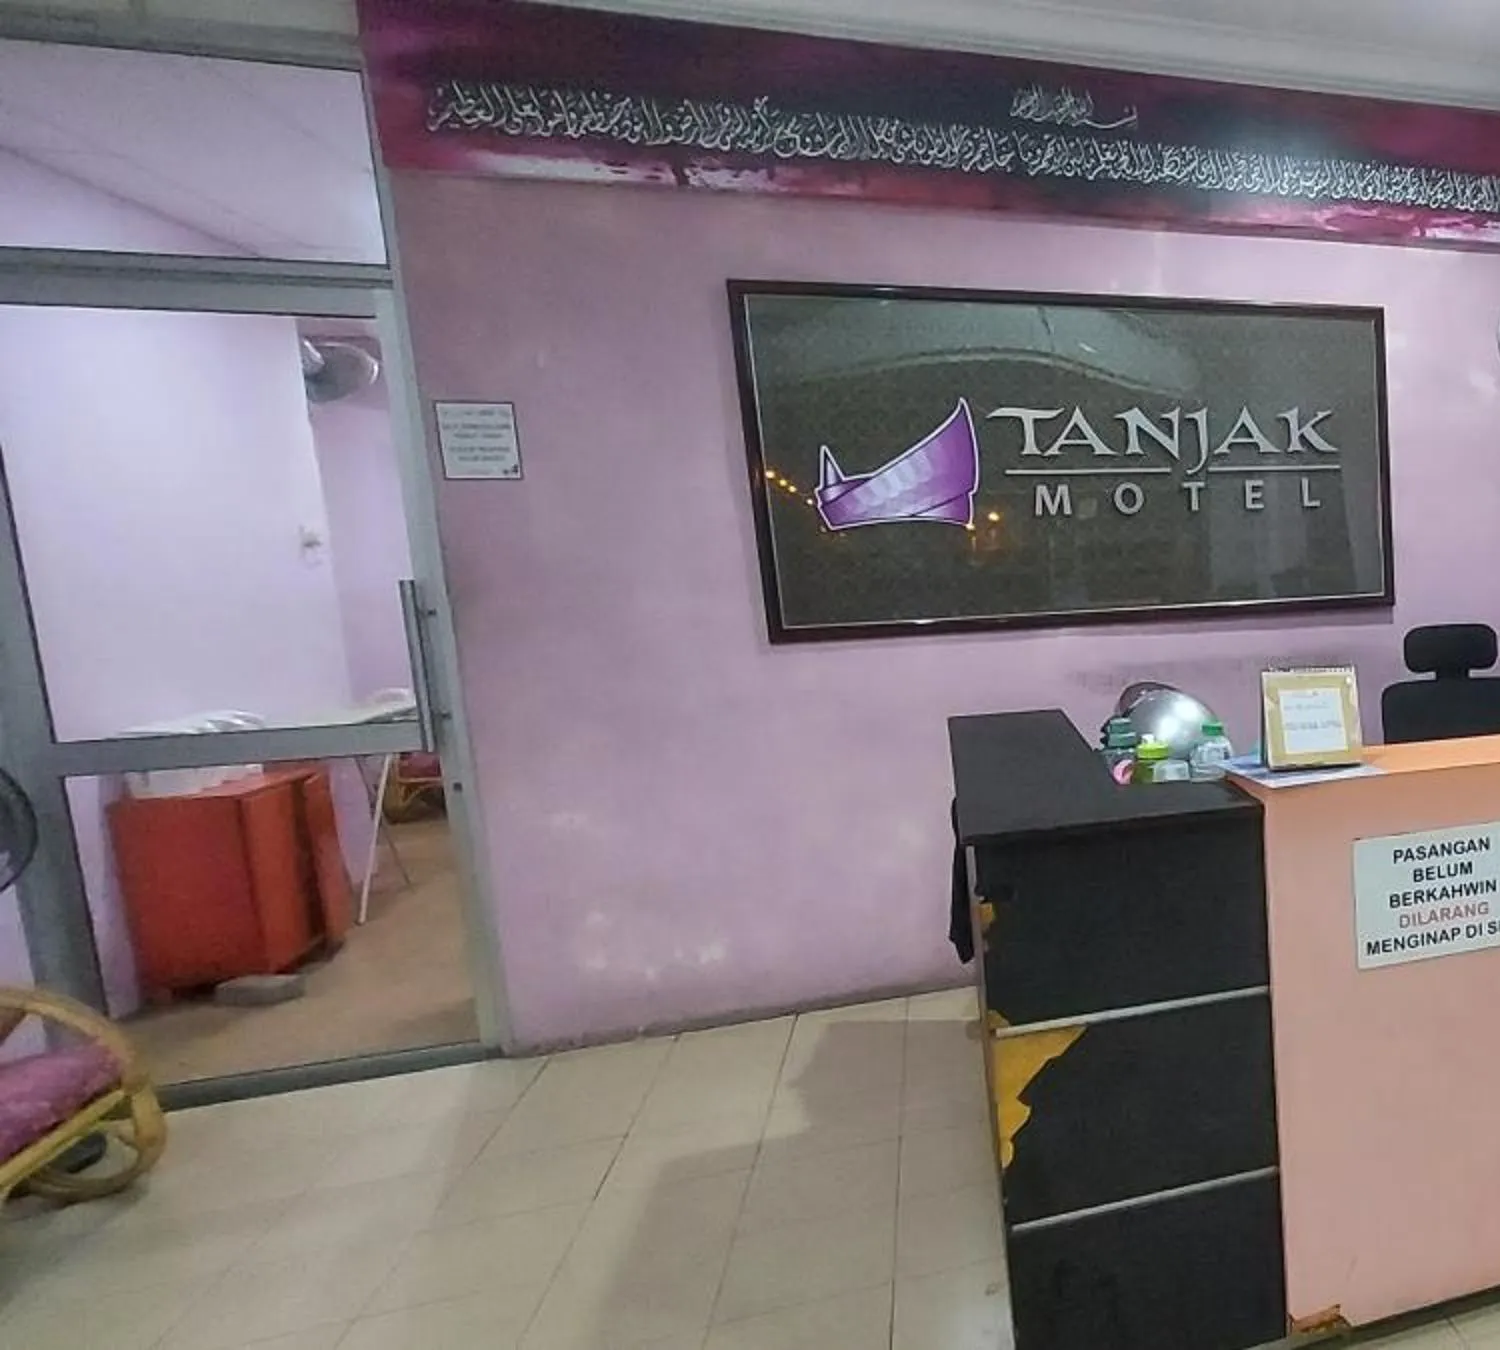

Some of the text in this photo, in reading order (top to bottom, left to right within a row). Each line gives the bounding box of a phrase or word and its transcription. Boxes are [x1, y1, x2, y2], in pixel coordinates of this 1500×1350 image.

[986, 405, 1339, 475] TANJAK
[1034, 478, 1321, 516] MOTEL
[1393, 836, 1491, 864] PASANGAN
[1413, 861, 1473, 883] BELUM
[1389, 879, 1497, 909] BERKAHWIN
[1399, 901, 1489, 929] DILARANG
[1367, 927, 1461, 956] MENGINAP
[1465, 923, 1483, 939] DI
